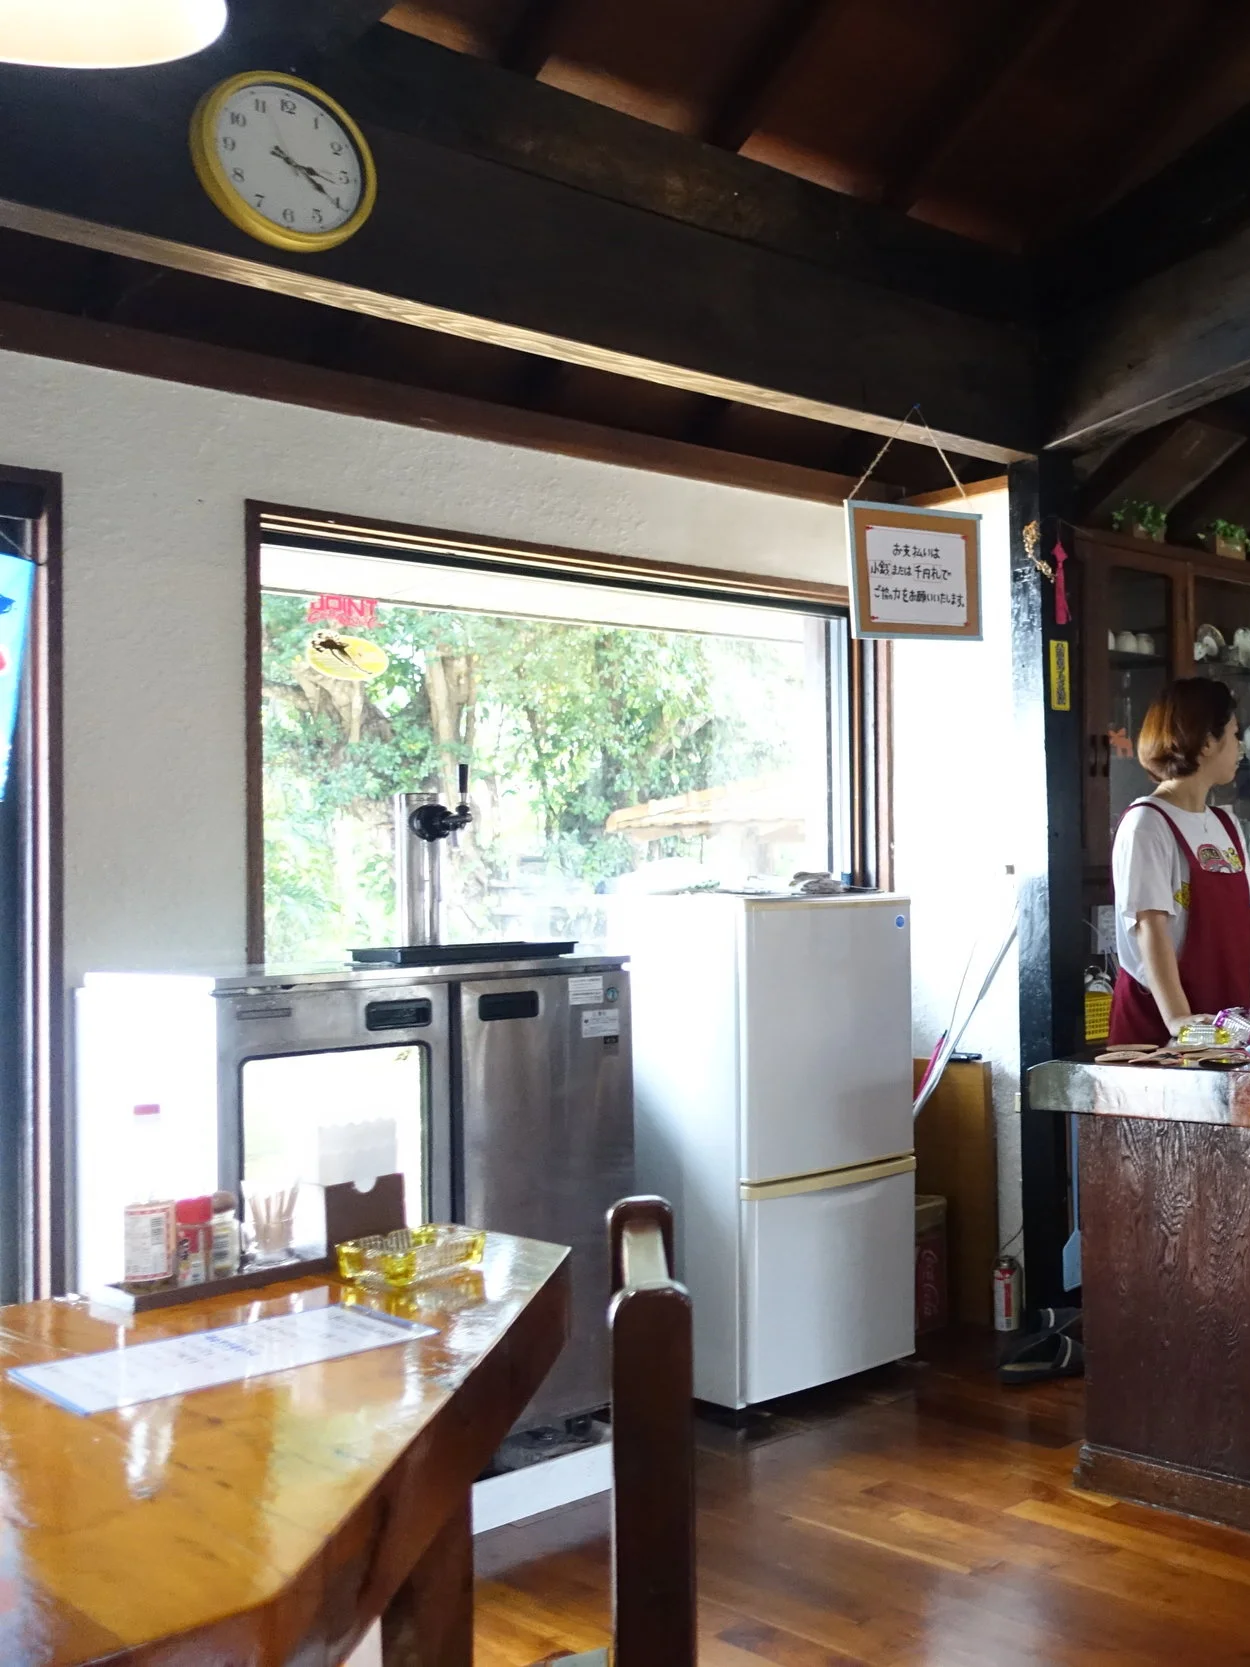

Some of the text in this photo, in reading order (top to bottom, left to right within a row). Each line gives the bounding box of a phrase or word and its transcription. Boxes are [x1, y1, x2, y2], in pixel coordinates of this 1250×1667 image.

[254, 98, 266, 114] 11
[280, 99, 297, 115] 12
[230, 111, 247, 127] 10
[222, 136, 236, 151] 9
[330, 141, 344, 156] 2
[232, 167, 245, 183] 8
[339, 170, 350, 185] 3
[254, 193, 265, 207] 7
[282, 208, 295, 223] 6
[312, 208, 323, 223] 5
[892, 543, 940, 559] お支払いは
